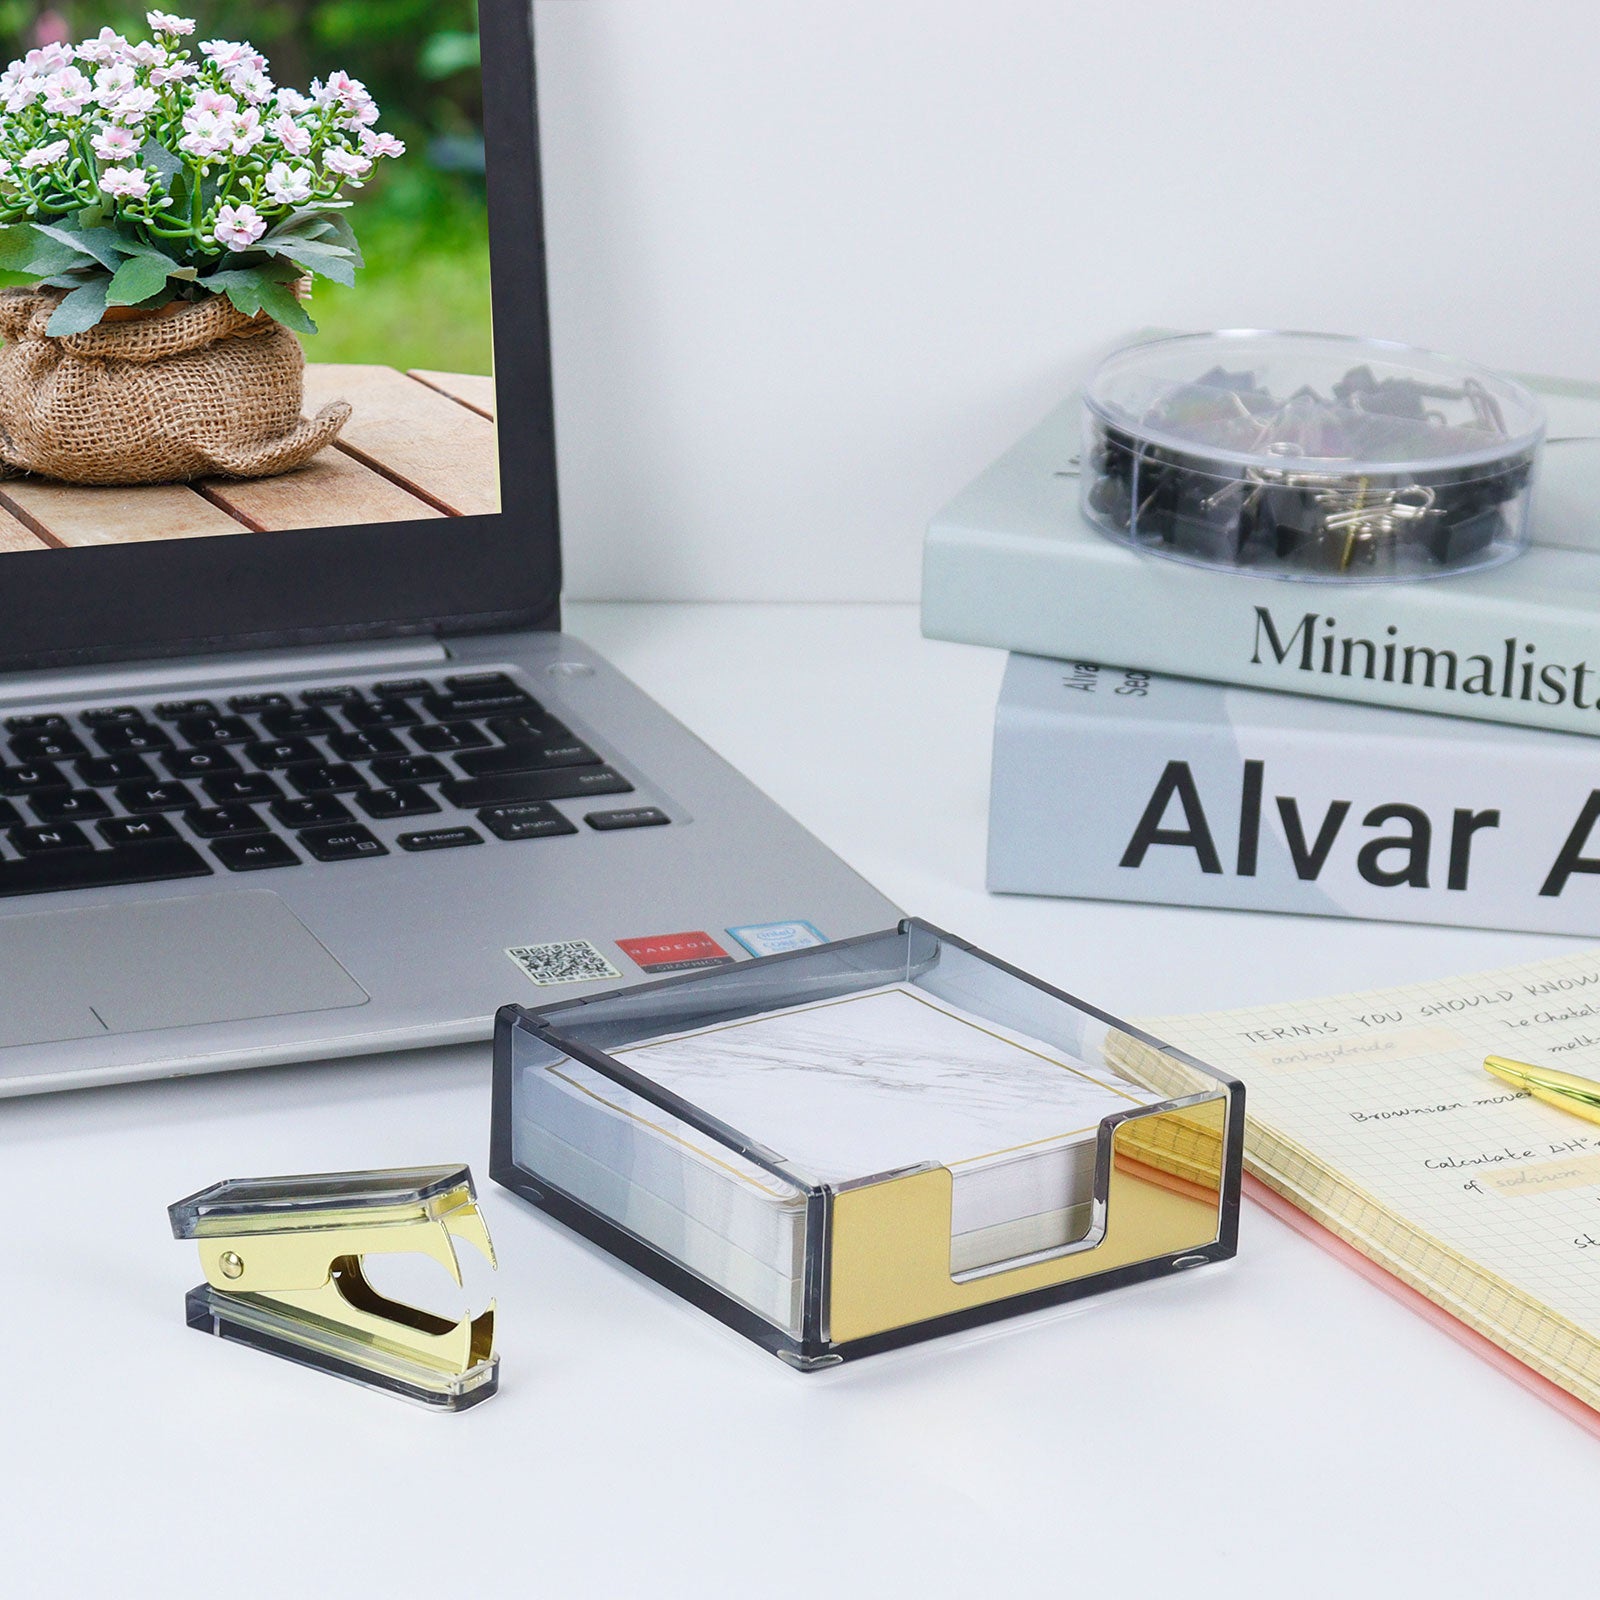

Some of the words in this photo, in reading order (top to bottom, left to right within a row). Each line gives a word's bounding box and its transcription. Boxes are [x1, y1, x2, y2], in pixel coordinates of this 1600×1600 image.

[1251, 605, 1600, 710] Minimalist
[579, 772, 613, 783] Shift
[234, 782, 251, 792] L
[146, 790, 166, 800] K
[63, 798, 78, 809] J
[126, 823, 150, 834] M
[1118, 759, 1501, 891] Alvar
[38, 832, 61, 843] N
[327, 835, 356, 845] Ctrl
[245, 846, 266, 855] Alt
[631, 941, 713, 955] RADEON
[656, 958, 723, 971] GRAPHICS
[1237, 1020, 1339, 1044] TERMS
[1351, 1010, 1403, 1028] YOU
[1420, 990, 1514, 1017] SHOULD
[1523, 972, 1599, 997] KNOW
[1534, 1003, 1600, 1024] Chatel
[1547, 1034, 1600, 1053] melt
[1349, 1102, 1467, 1123] Brownian
[1424, 1148, 1537, 1170] Calculate
[1463, 1179, 1484, 1195] of
[1496, 1169, 1583, 1188] sodium
